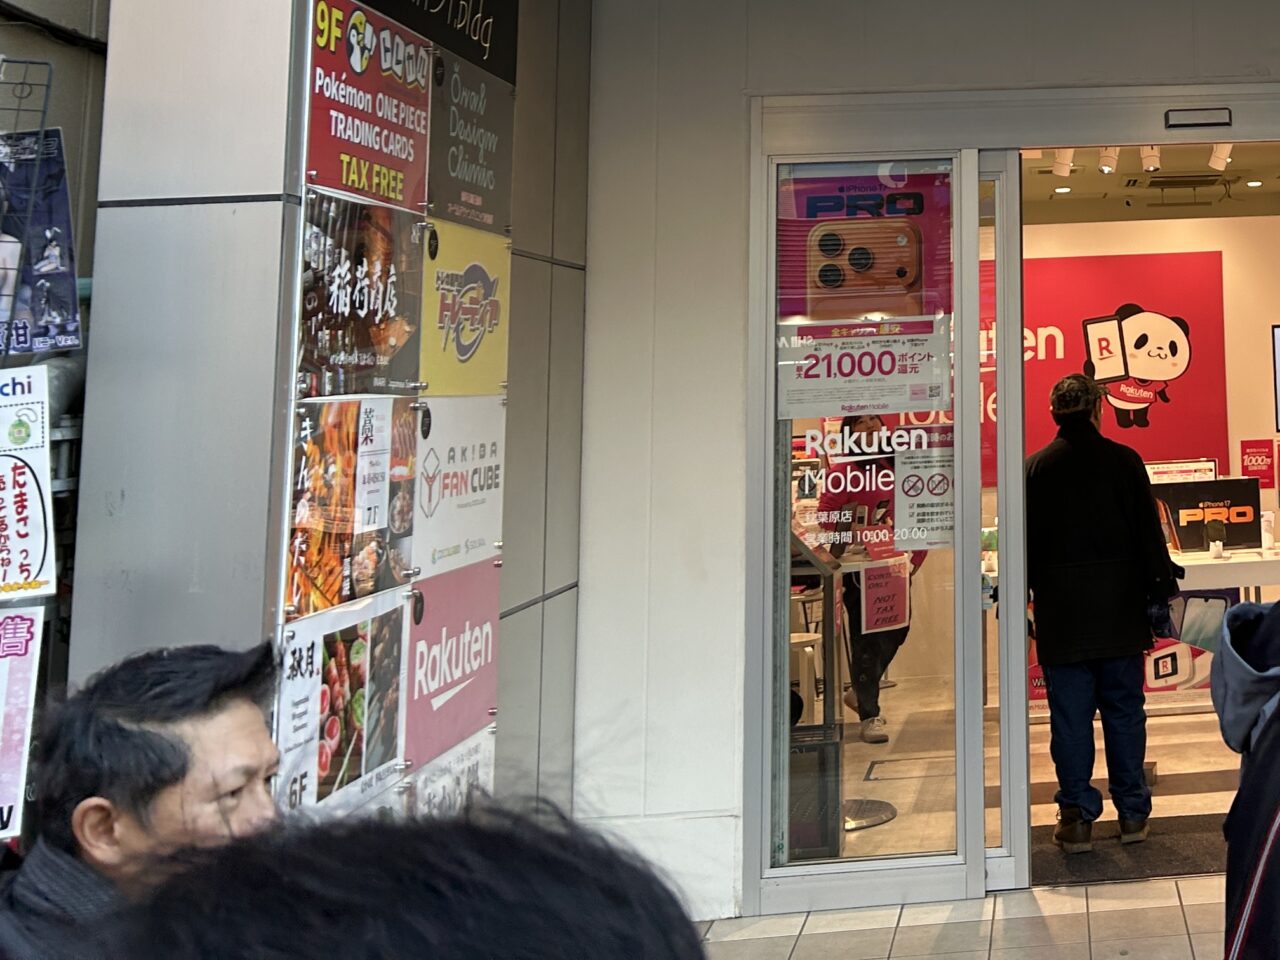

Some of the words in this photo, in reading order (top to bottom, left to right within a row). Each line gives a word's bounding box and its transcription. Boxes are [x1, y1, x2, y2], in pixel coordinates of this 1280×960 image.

[316, 0, 343, 51] 9F
[315, 67, 372, 114] Pokémon
[376, 92, 398, 123] ONE
[400, 103, 426, 135] PIECE
[330, 110, 380, 150] TRADING
[382, 129, 414, 162] CARDS
[340, 153, 369, 193] TAX
[372, 163, 404, 201] FREE
[806, 192, 924, 218] PRO
[803, 350, 896, 379] 21,000
[898, 352, 934, 363] ポイント
[1120, 384, 1153, 399] Rakuten
[805, 426, 928, 456] Rakuten
[442, 471, 469, 499] FAN
[472, 464, 500, 492] CUBE
[804, 464, 895, 494] Mobile
[1178, 506, 1254, 526] PRO
[286, 640, 315, 681] 秋月
[414, 621, 492, 700] Rakuten
